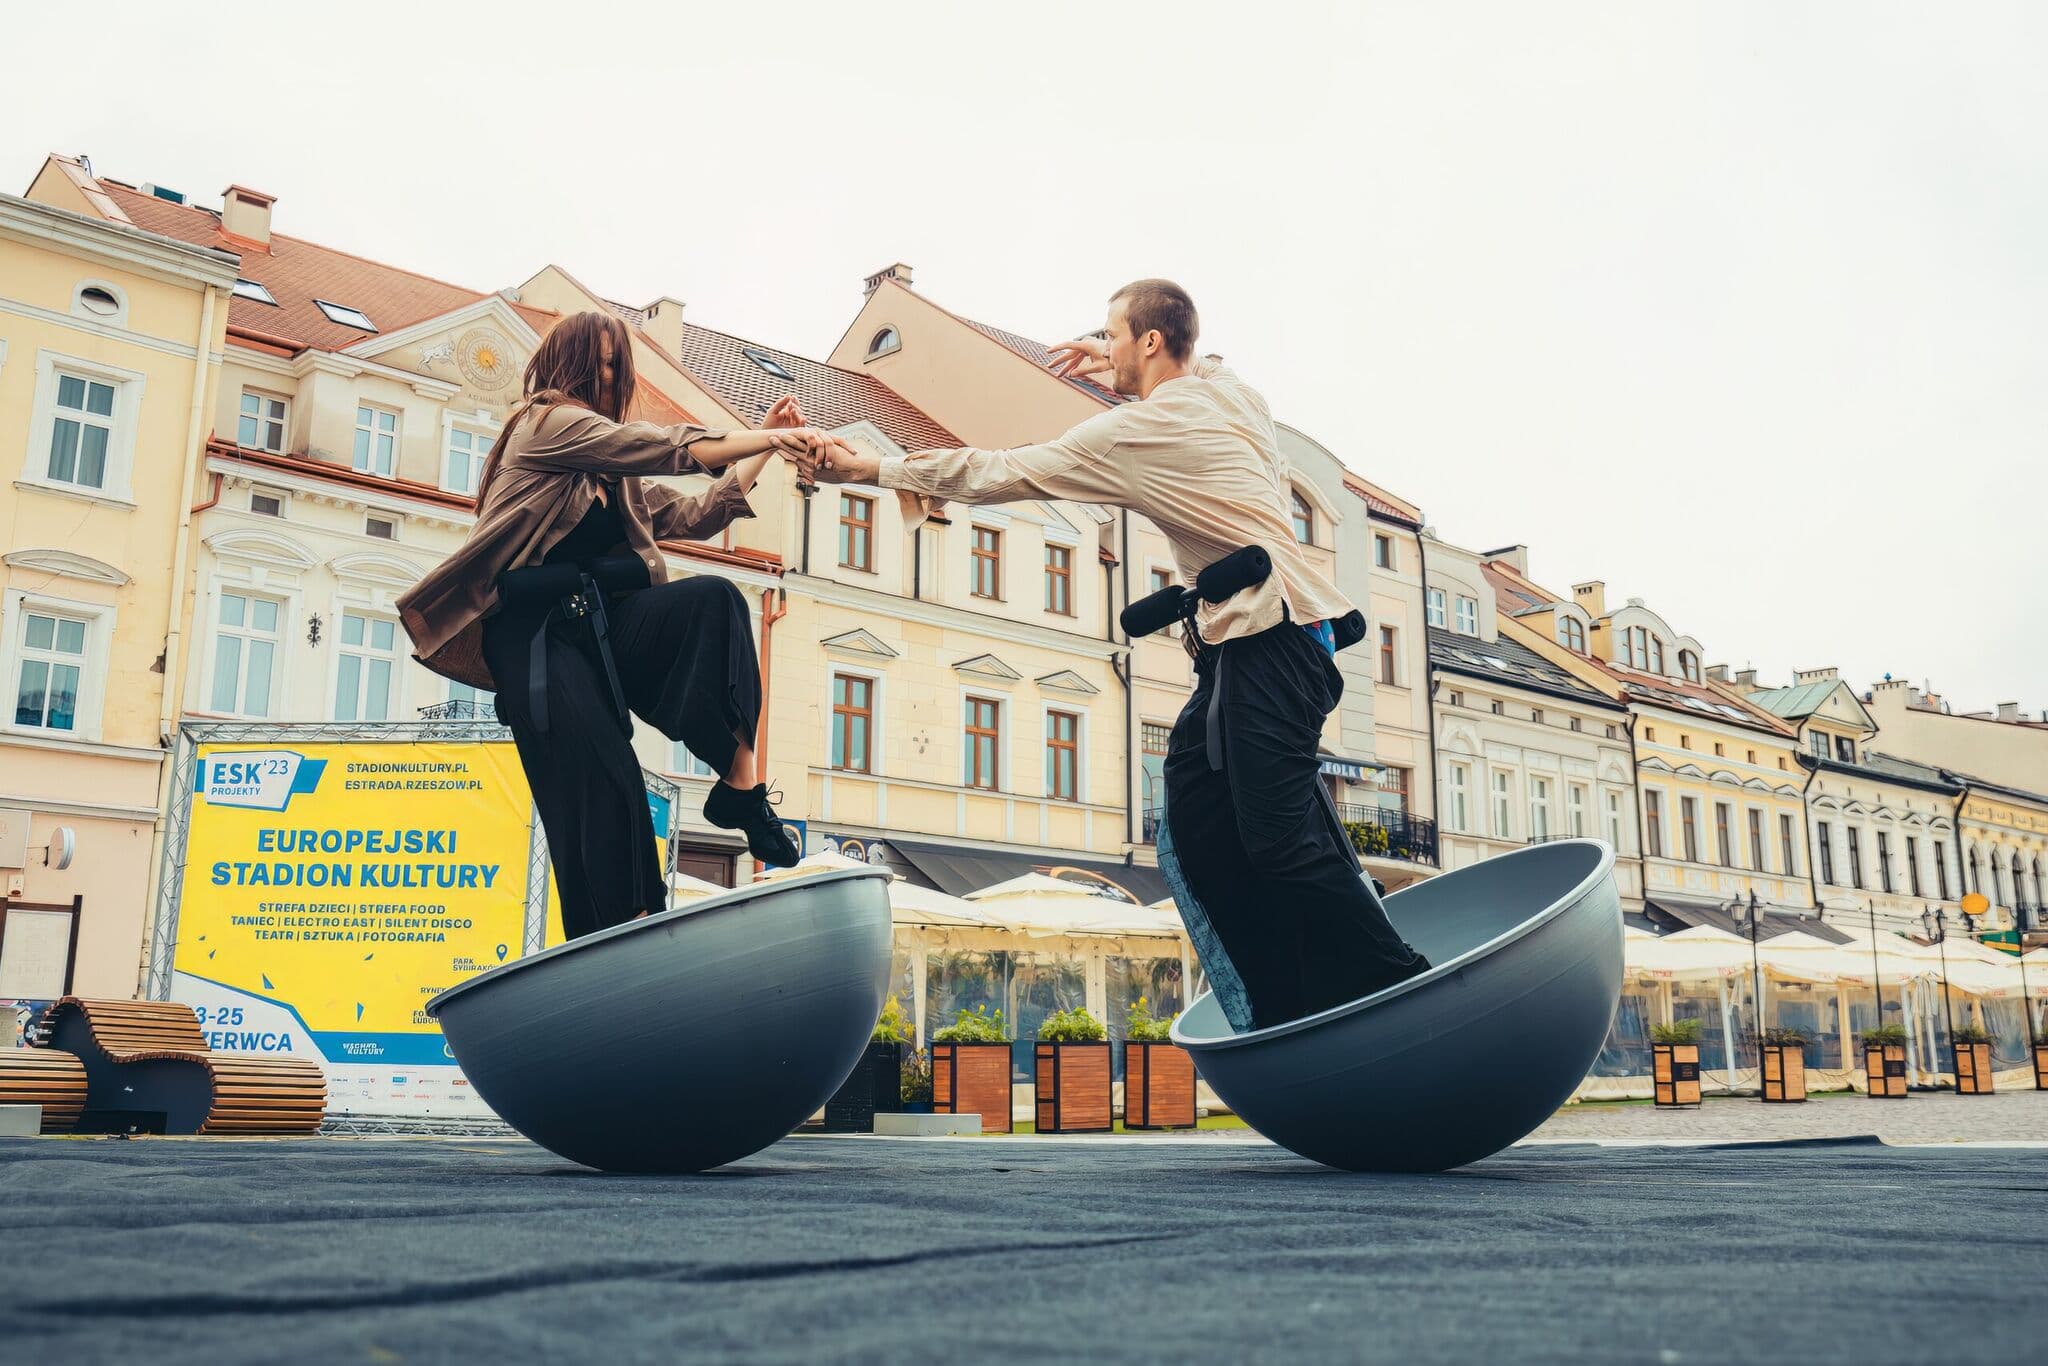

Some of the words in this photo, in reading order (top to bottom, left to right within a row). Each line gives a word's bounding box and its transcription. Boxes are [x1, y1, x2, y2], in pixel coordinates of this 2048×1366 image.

[212, 762, 261, 785] ESK
[346, 762, 469, 774] STADIONKULTURY.PL
[210, 786, 261, 796] PROJEKTY
[344, 779, 483, 791] ESTRADA.RZESZOW.PL
[257, 829, 457, 854] EUROPEJSKI
[211, 862, 353, 887] STADION
[359, 864, 501, 888] KULTURY
[258, 902, 306, 913] STREFA
[309, 903, 351, 914] DZIECI
[359, 904, 407, 914] STREFA
[409, 904, 446, 915] FOOD
[231, 916, 275, 926] TANIEC
[283, 916, 341, 928] ELECTRO
[343, 918, 376, 928] EAST
[385, 918, 429, 928] SILENT
[430, 918, 473, 929] DISCO
[254, 930, 295, 941] TEATR
[302, 930, 354, 942] SZTUKA
[362, 931, 446, 943] FOTOGRAFIA
[195, 1006, 243, 1026] 3-25
[203, 1031, 293, 1051] ERWCA
